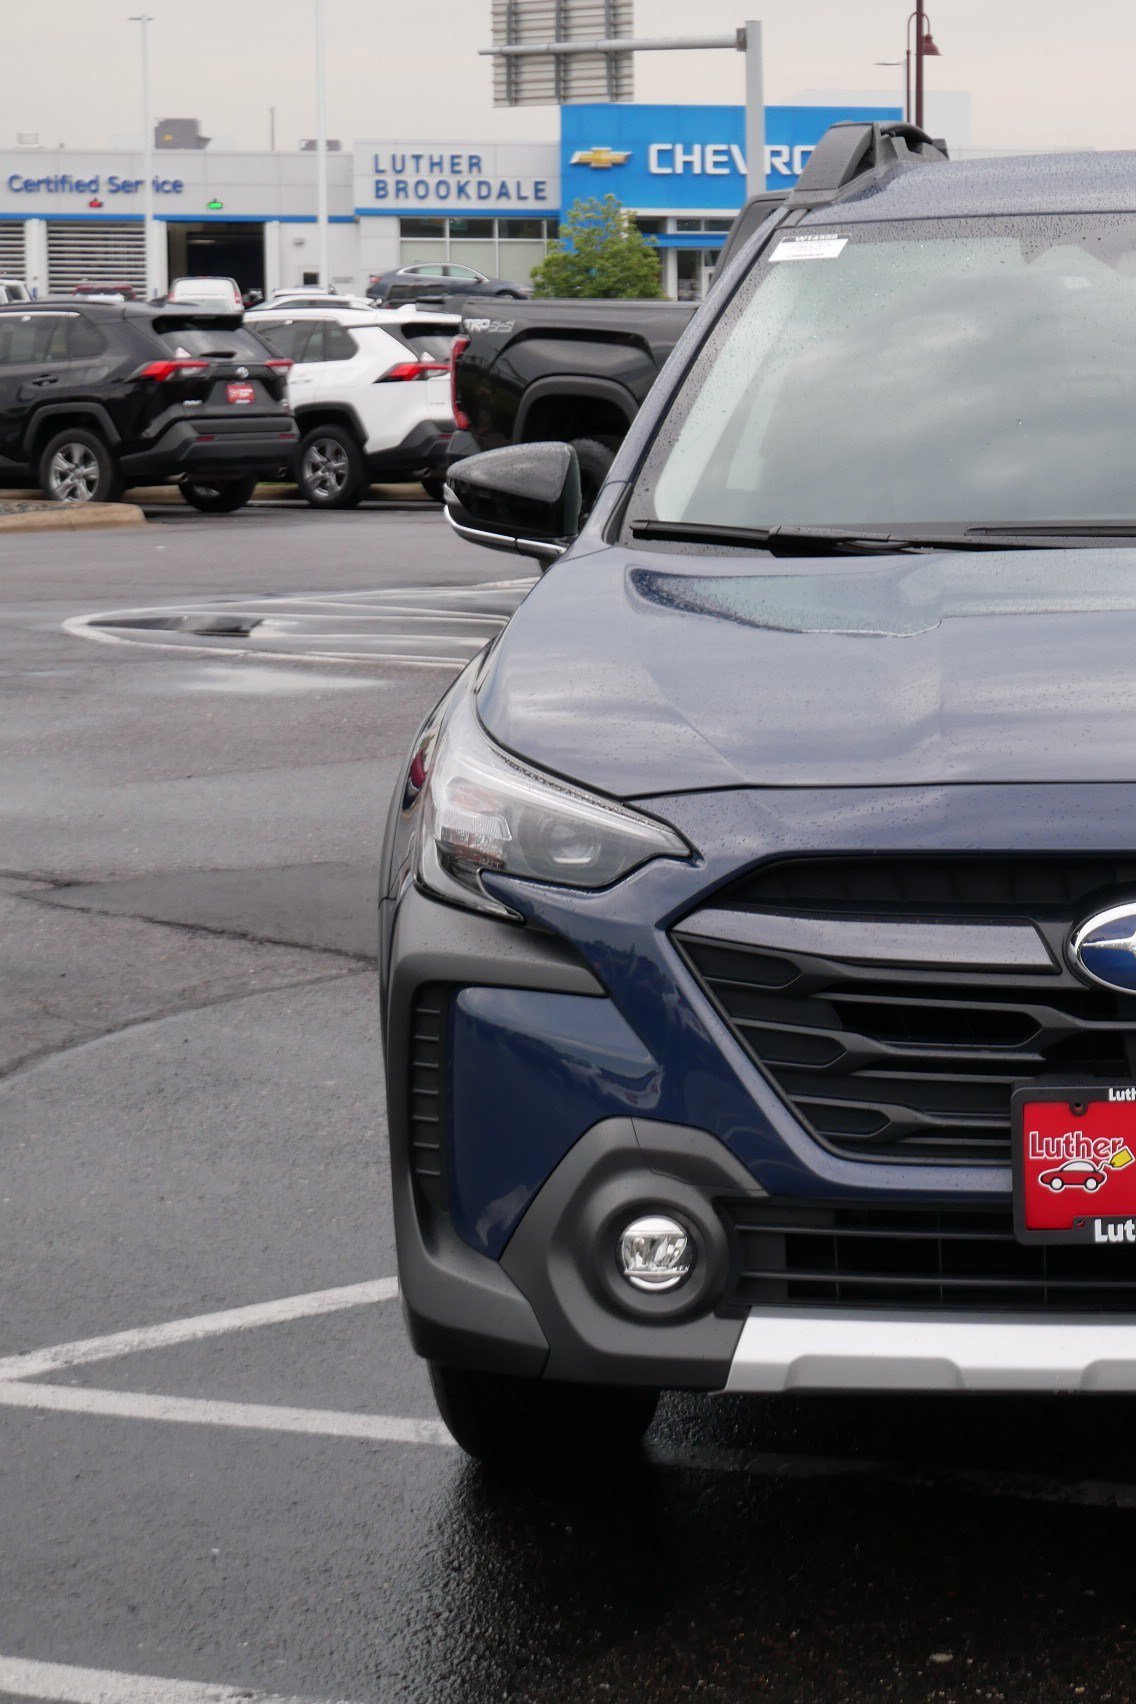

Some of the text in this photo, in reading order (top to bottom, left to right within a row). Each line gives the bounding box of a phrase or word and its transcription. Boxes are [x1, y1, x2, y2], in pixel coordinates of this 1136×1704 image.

[374, 153, 483, 175] LUTHER
[8, 173, 184, 194] Certified Serice
[374, 179, 548, 201] BROOKDALE
[1028, 1131, 1125, 1160] Luther
